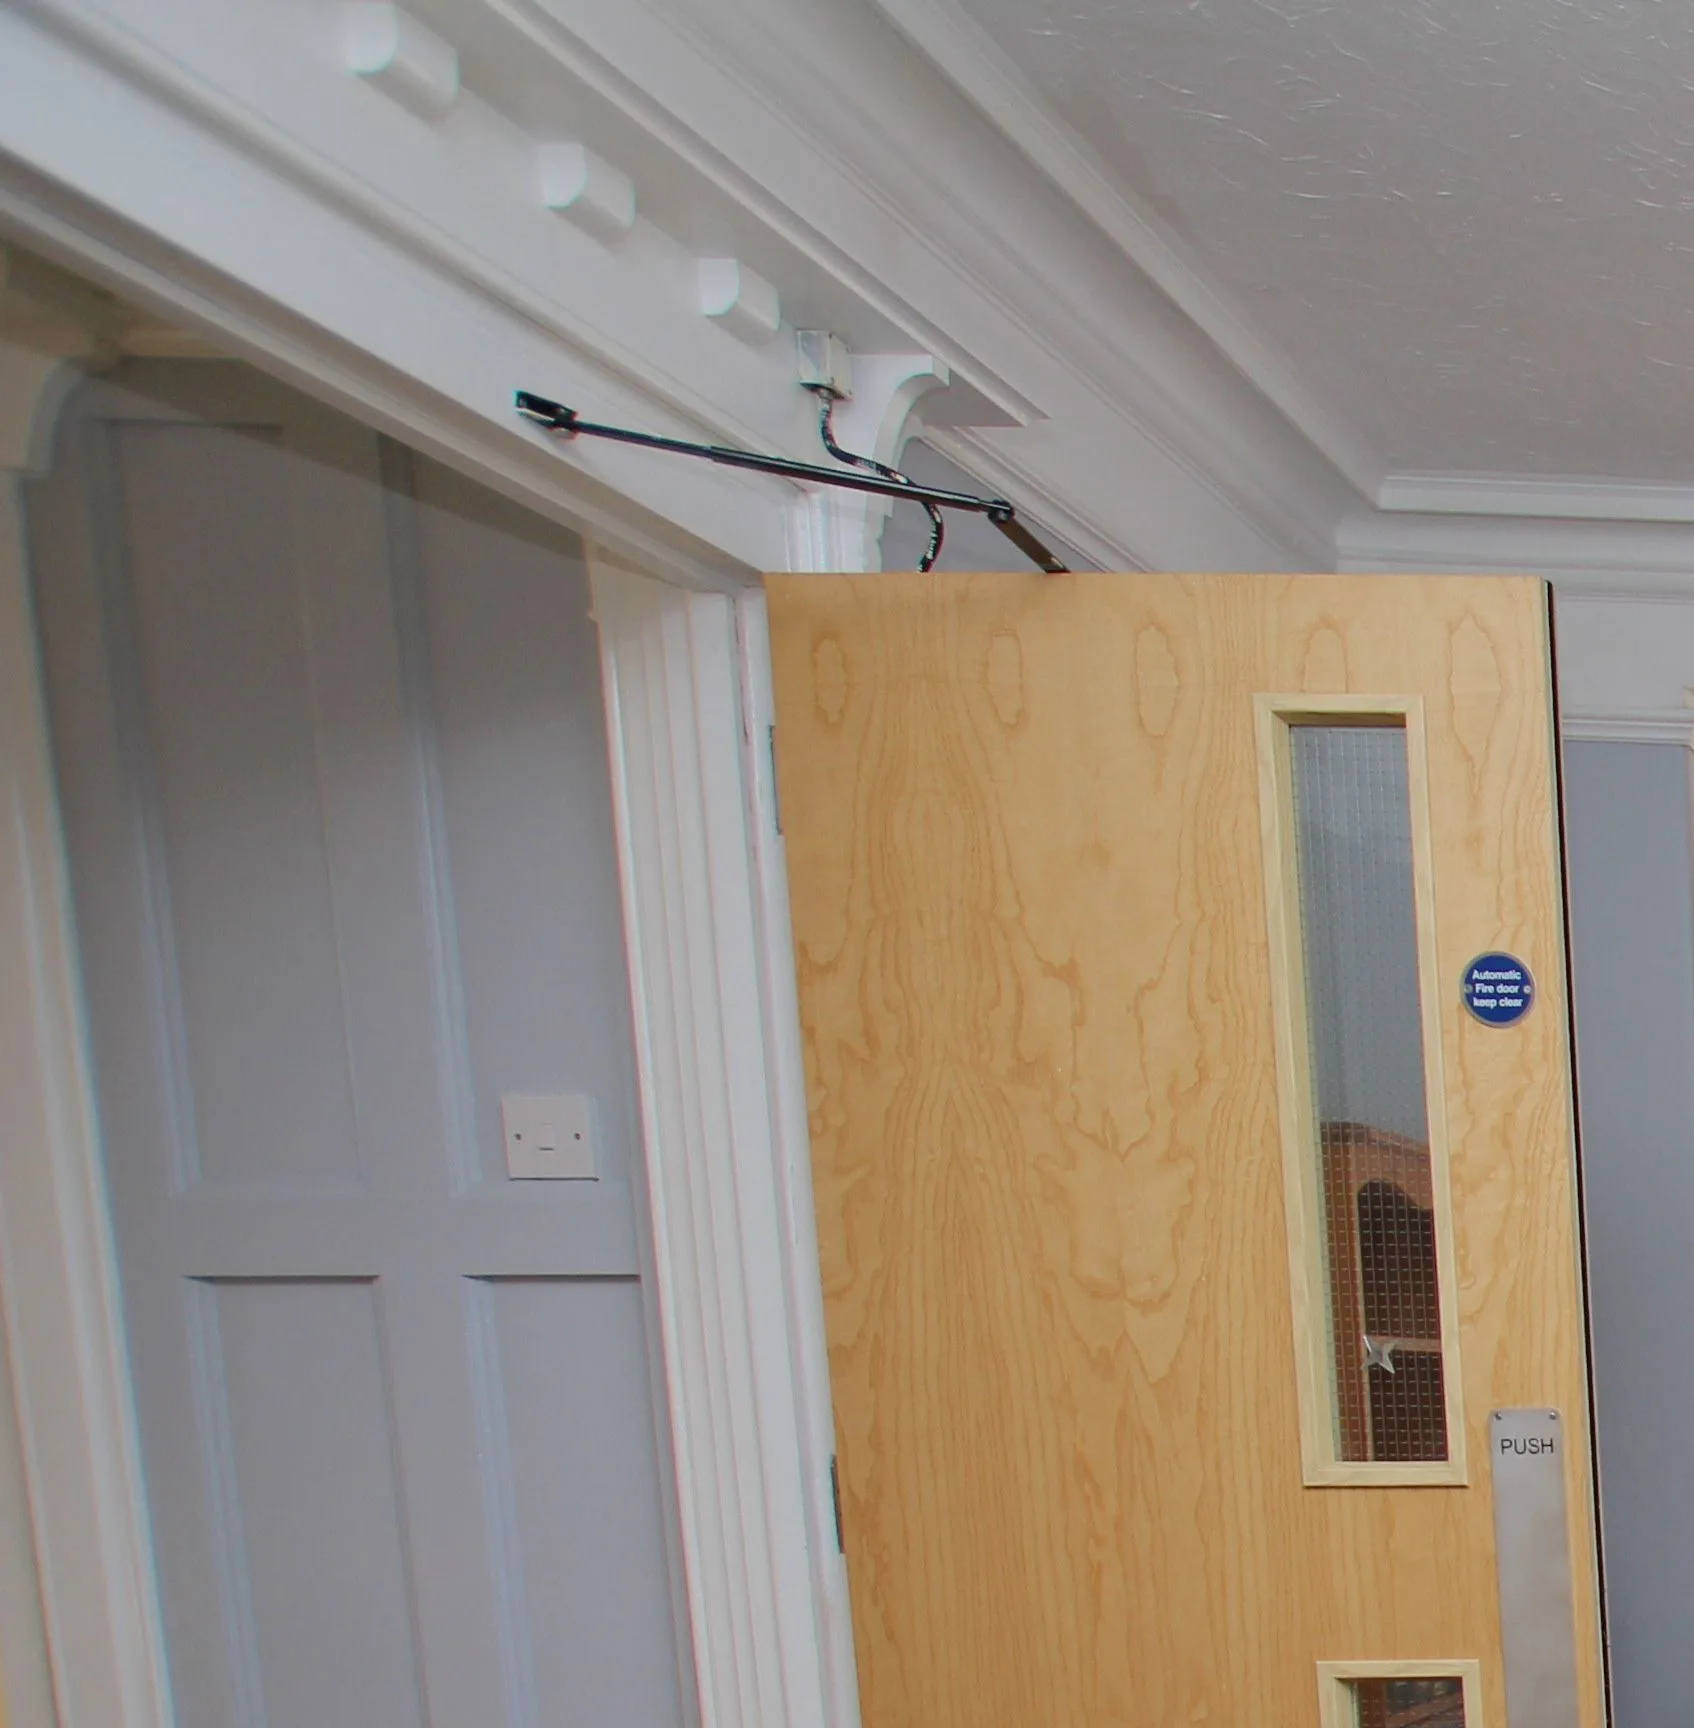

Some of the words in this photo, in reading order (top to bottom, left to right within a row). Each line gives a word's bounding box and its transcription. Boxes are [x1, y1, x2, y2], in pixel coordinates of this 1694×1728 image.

[1472, 969, 1521, 980] Automatic
[1475, 983, 1495, 994] Fire
[1496, 983, 1520, 994] door
[1473, 997, 1497, 1009] keep
[1499, 997, 1523, 1007] clear
[1500, 1437, 1554, 1455] PUSH
